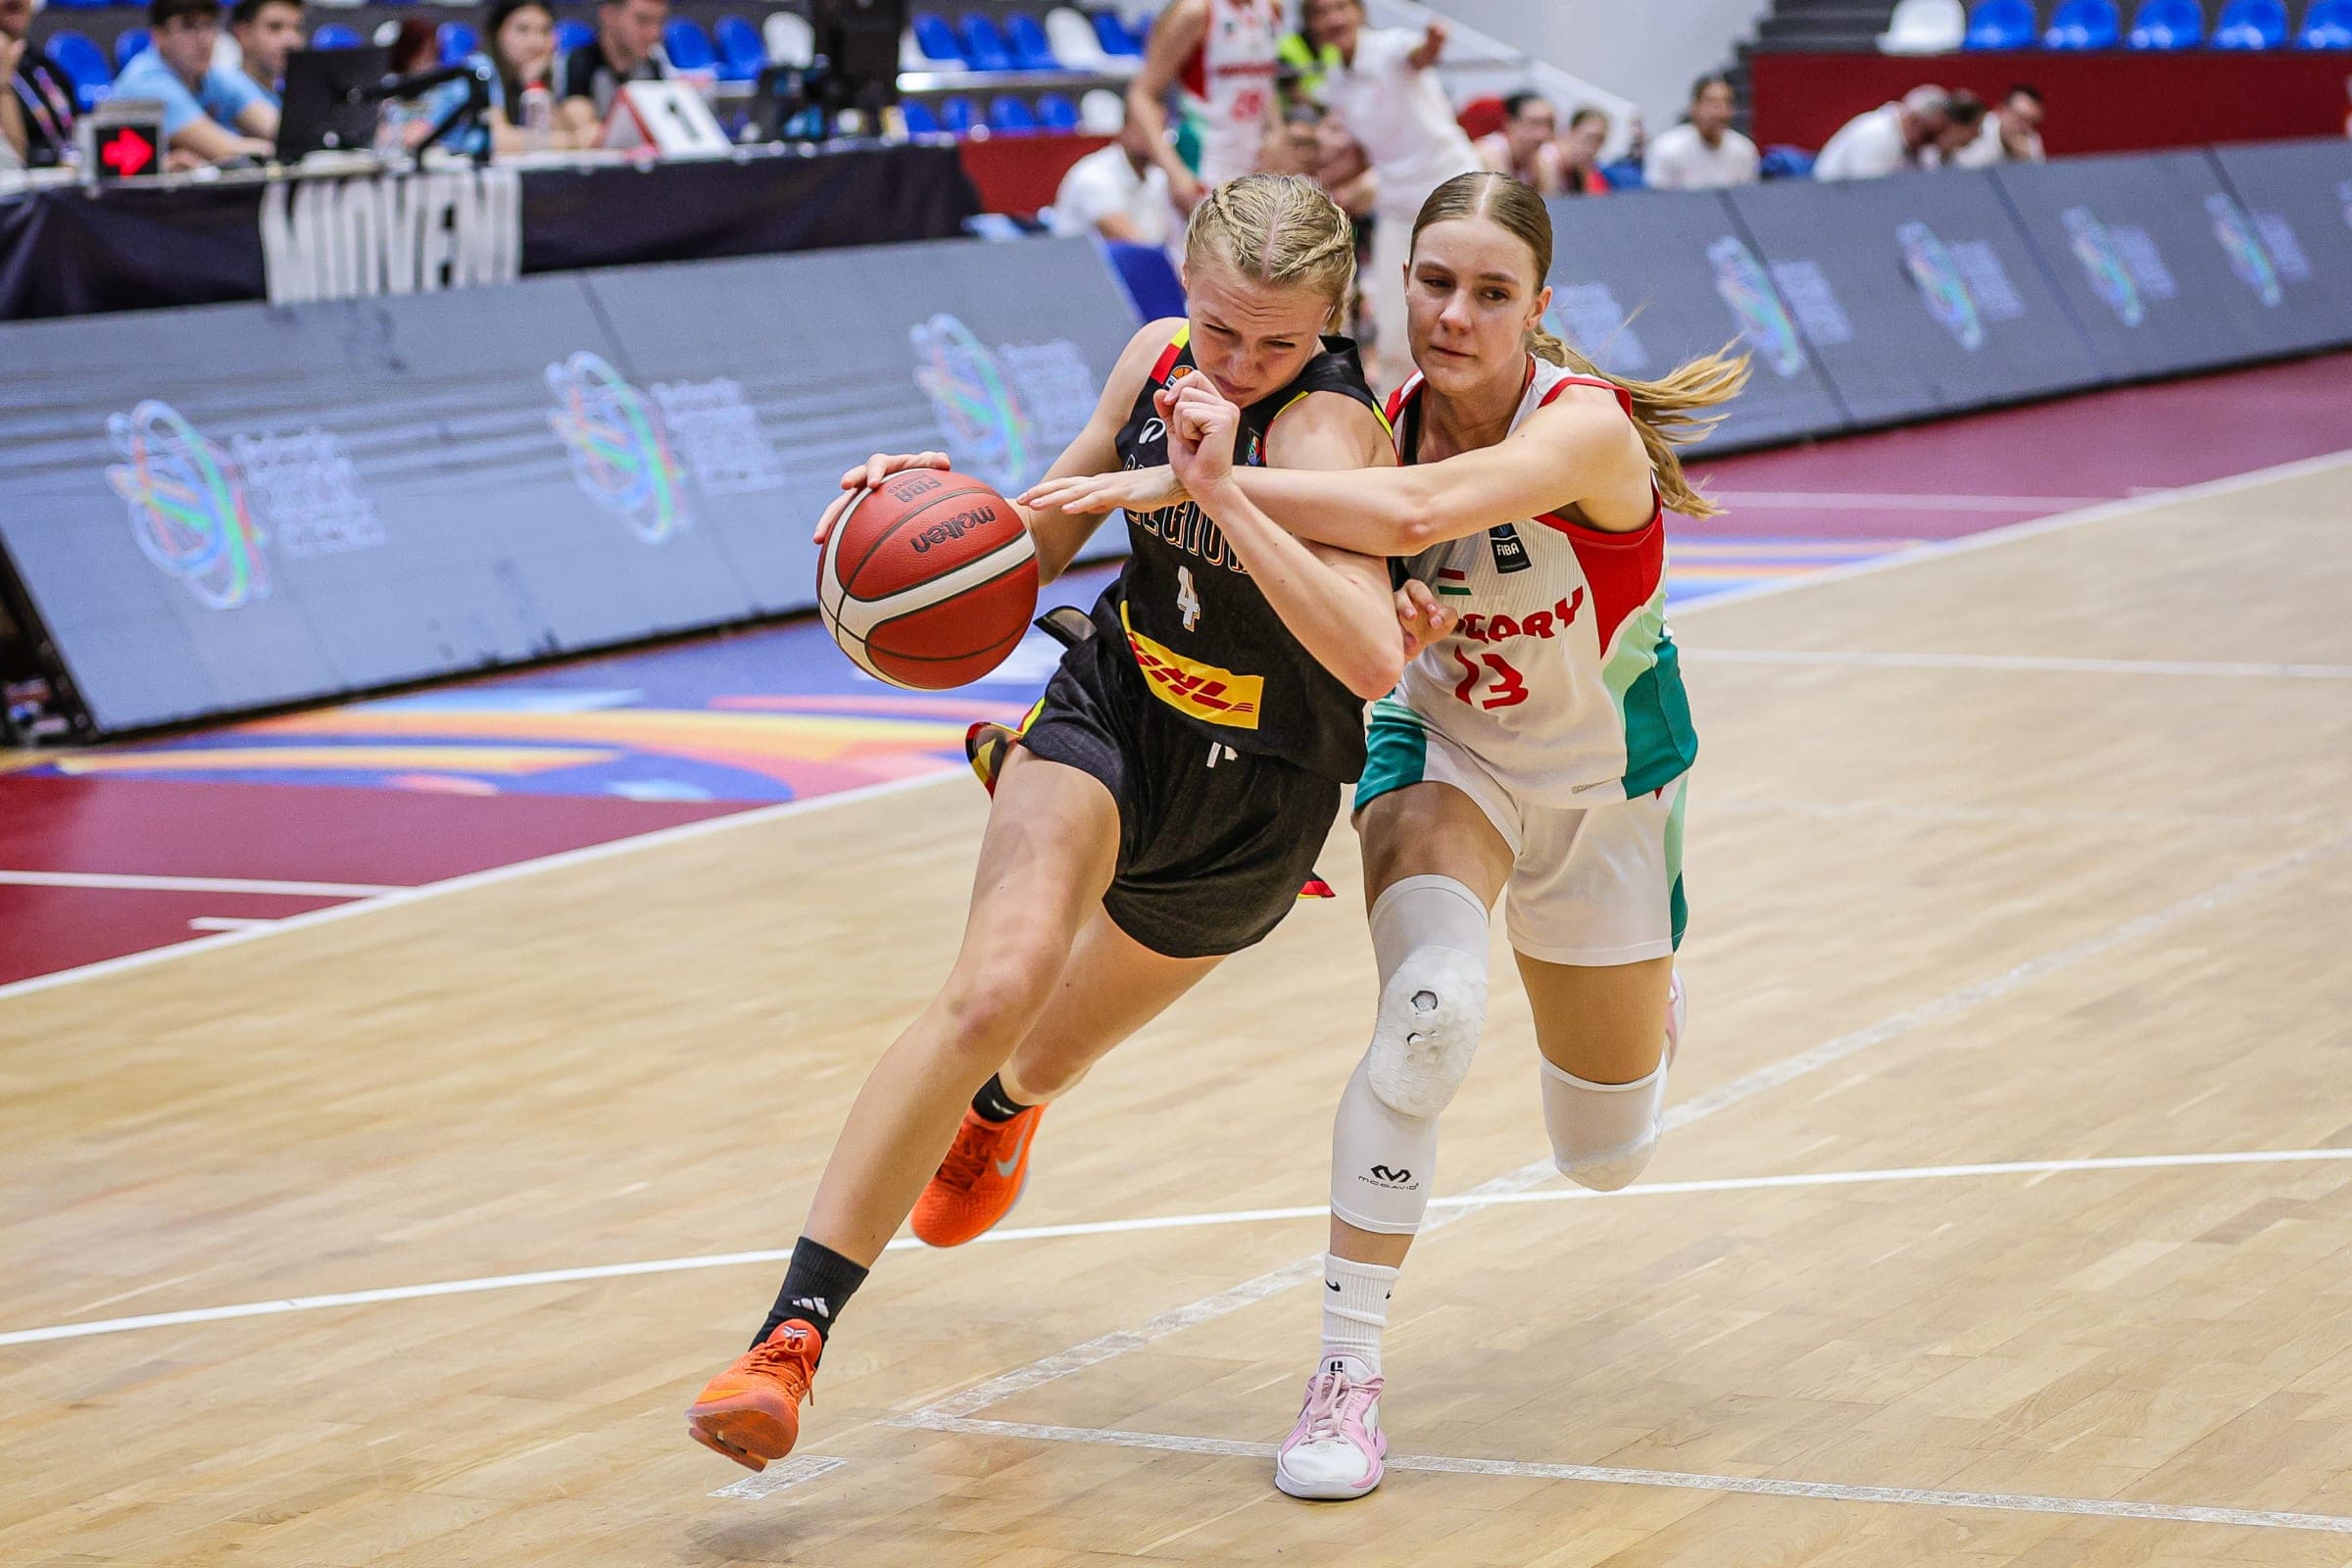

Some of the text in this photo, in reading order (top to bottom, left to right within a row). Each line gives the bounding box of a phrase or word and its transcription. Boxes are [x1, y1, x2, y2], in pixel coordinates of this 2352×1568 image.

[894, 476, 943, 503] FIBA
[909, 506, 996, 553] molten
[1496, 541, 1520, 556] FIBA
[1177, 564, 1200, 633] 4
[1454, 586, 1584, 645] GARY
[1127, 632, 1233, 710] DHL
[1454, 644, 1529, 710] 13
